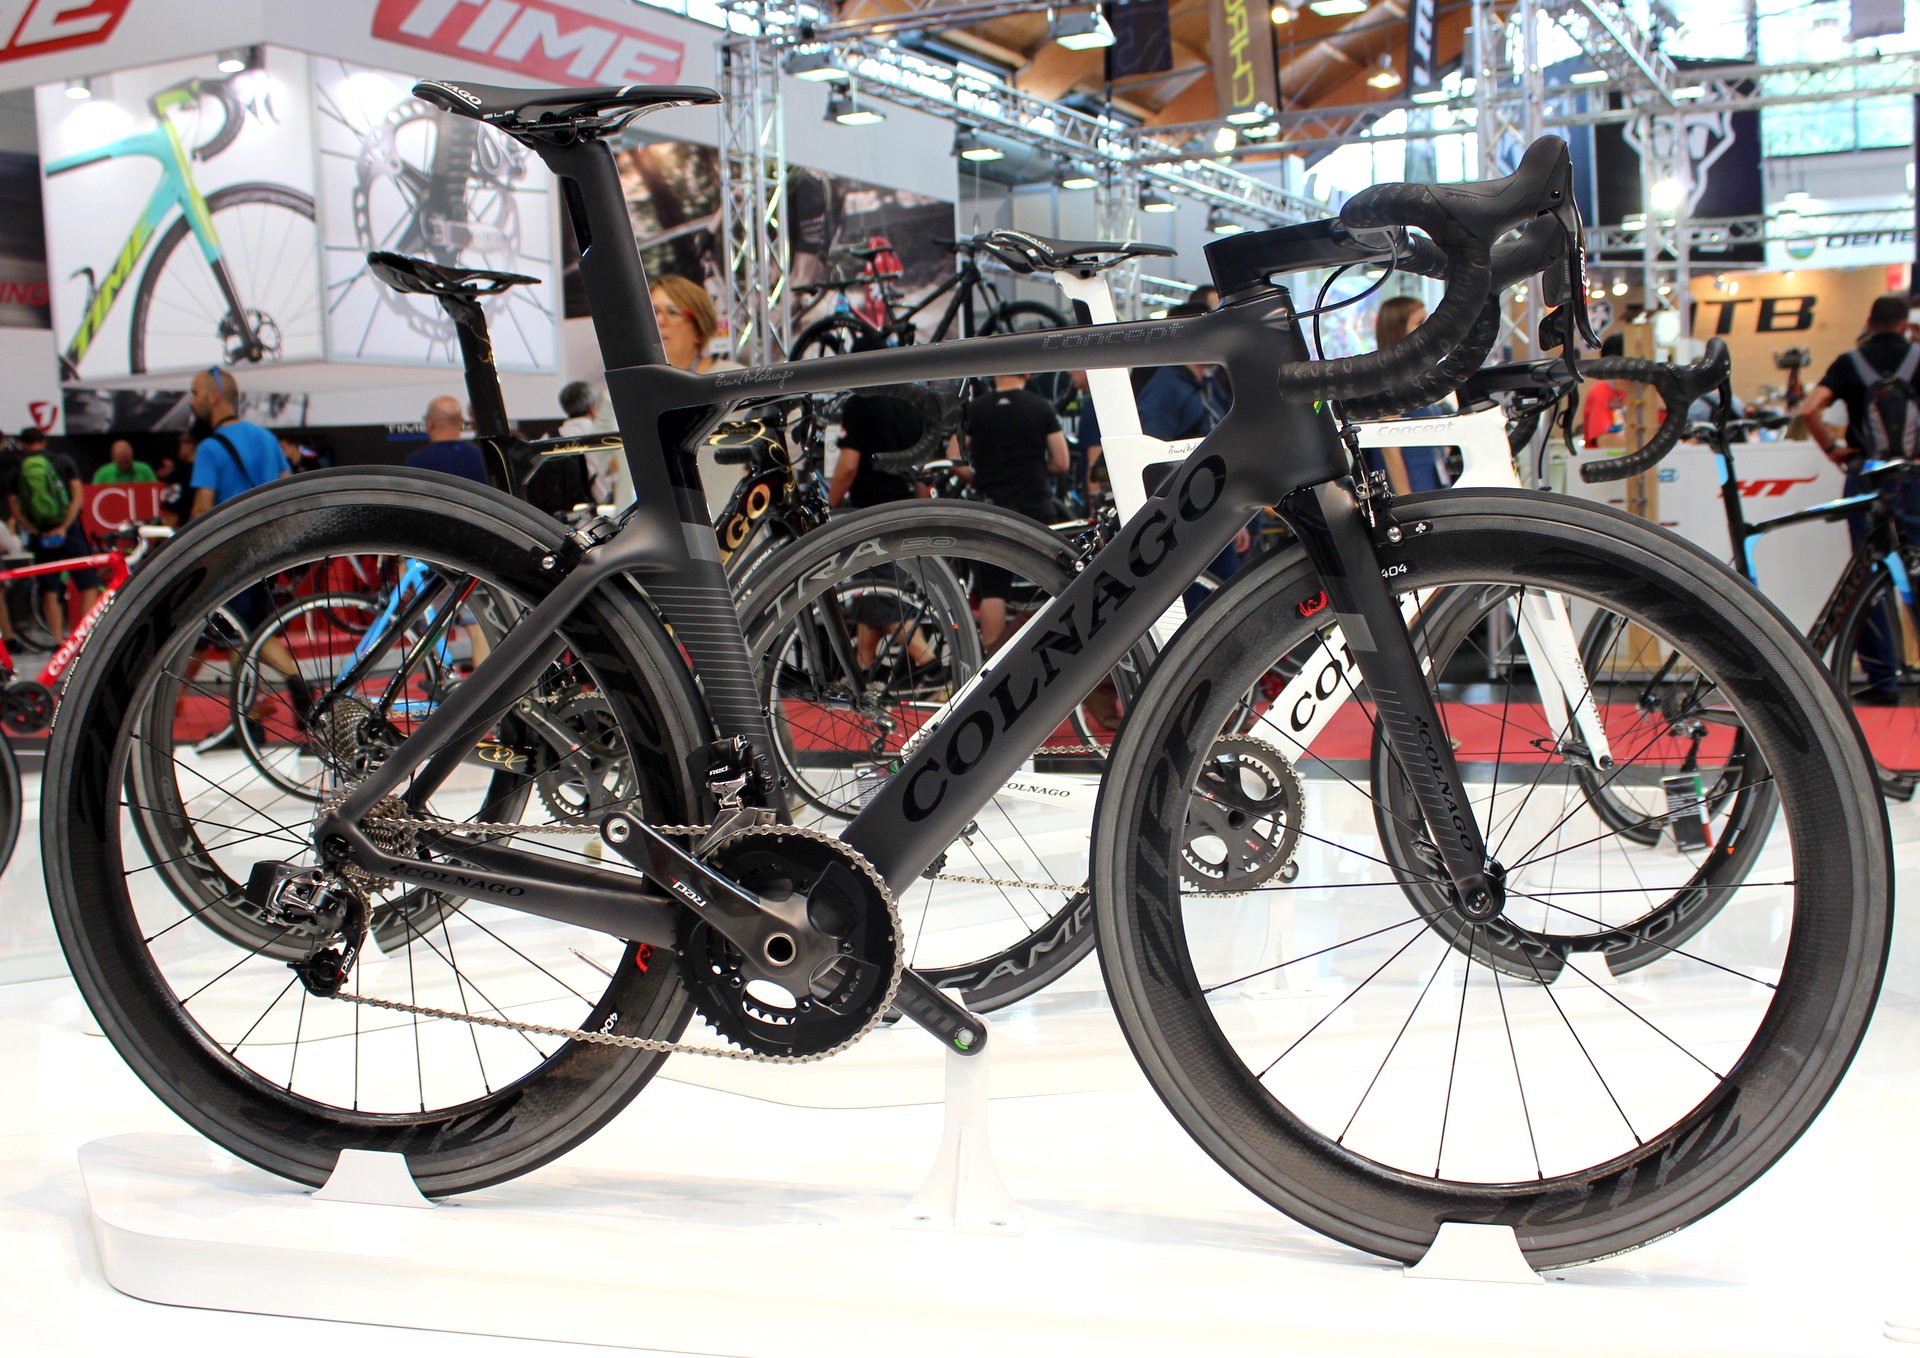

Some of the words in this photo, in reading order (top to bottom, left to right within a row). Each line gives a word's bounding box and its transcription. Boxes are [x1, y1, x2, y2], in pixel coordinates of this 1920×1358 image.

[398, 0, 681, 85] TIME
[1042, 322, 1184, 350] Concept
[1378, 421, 1455, 436] Concept
[901, 536, 957, 549] 50
[1381, 563, 1408, 579] 404
[902, 455, 1226, 822] COLNAGO
[1002, 782, 1071, 798] OLNAGO
[1419, 730, 1473, 853] COLNAGO
[1136, 679, 1212, 999] ZIPP
[403, 867, 526, 897] COLNAGO
